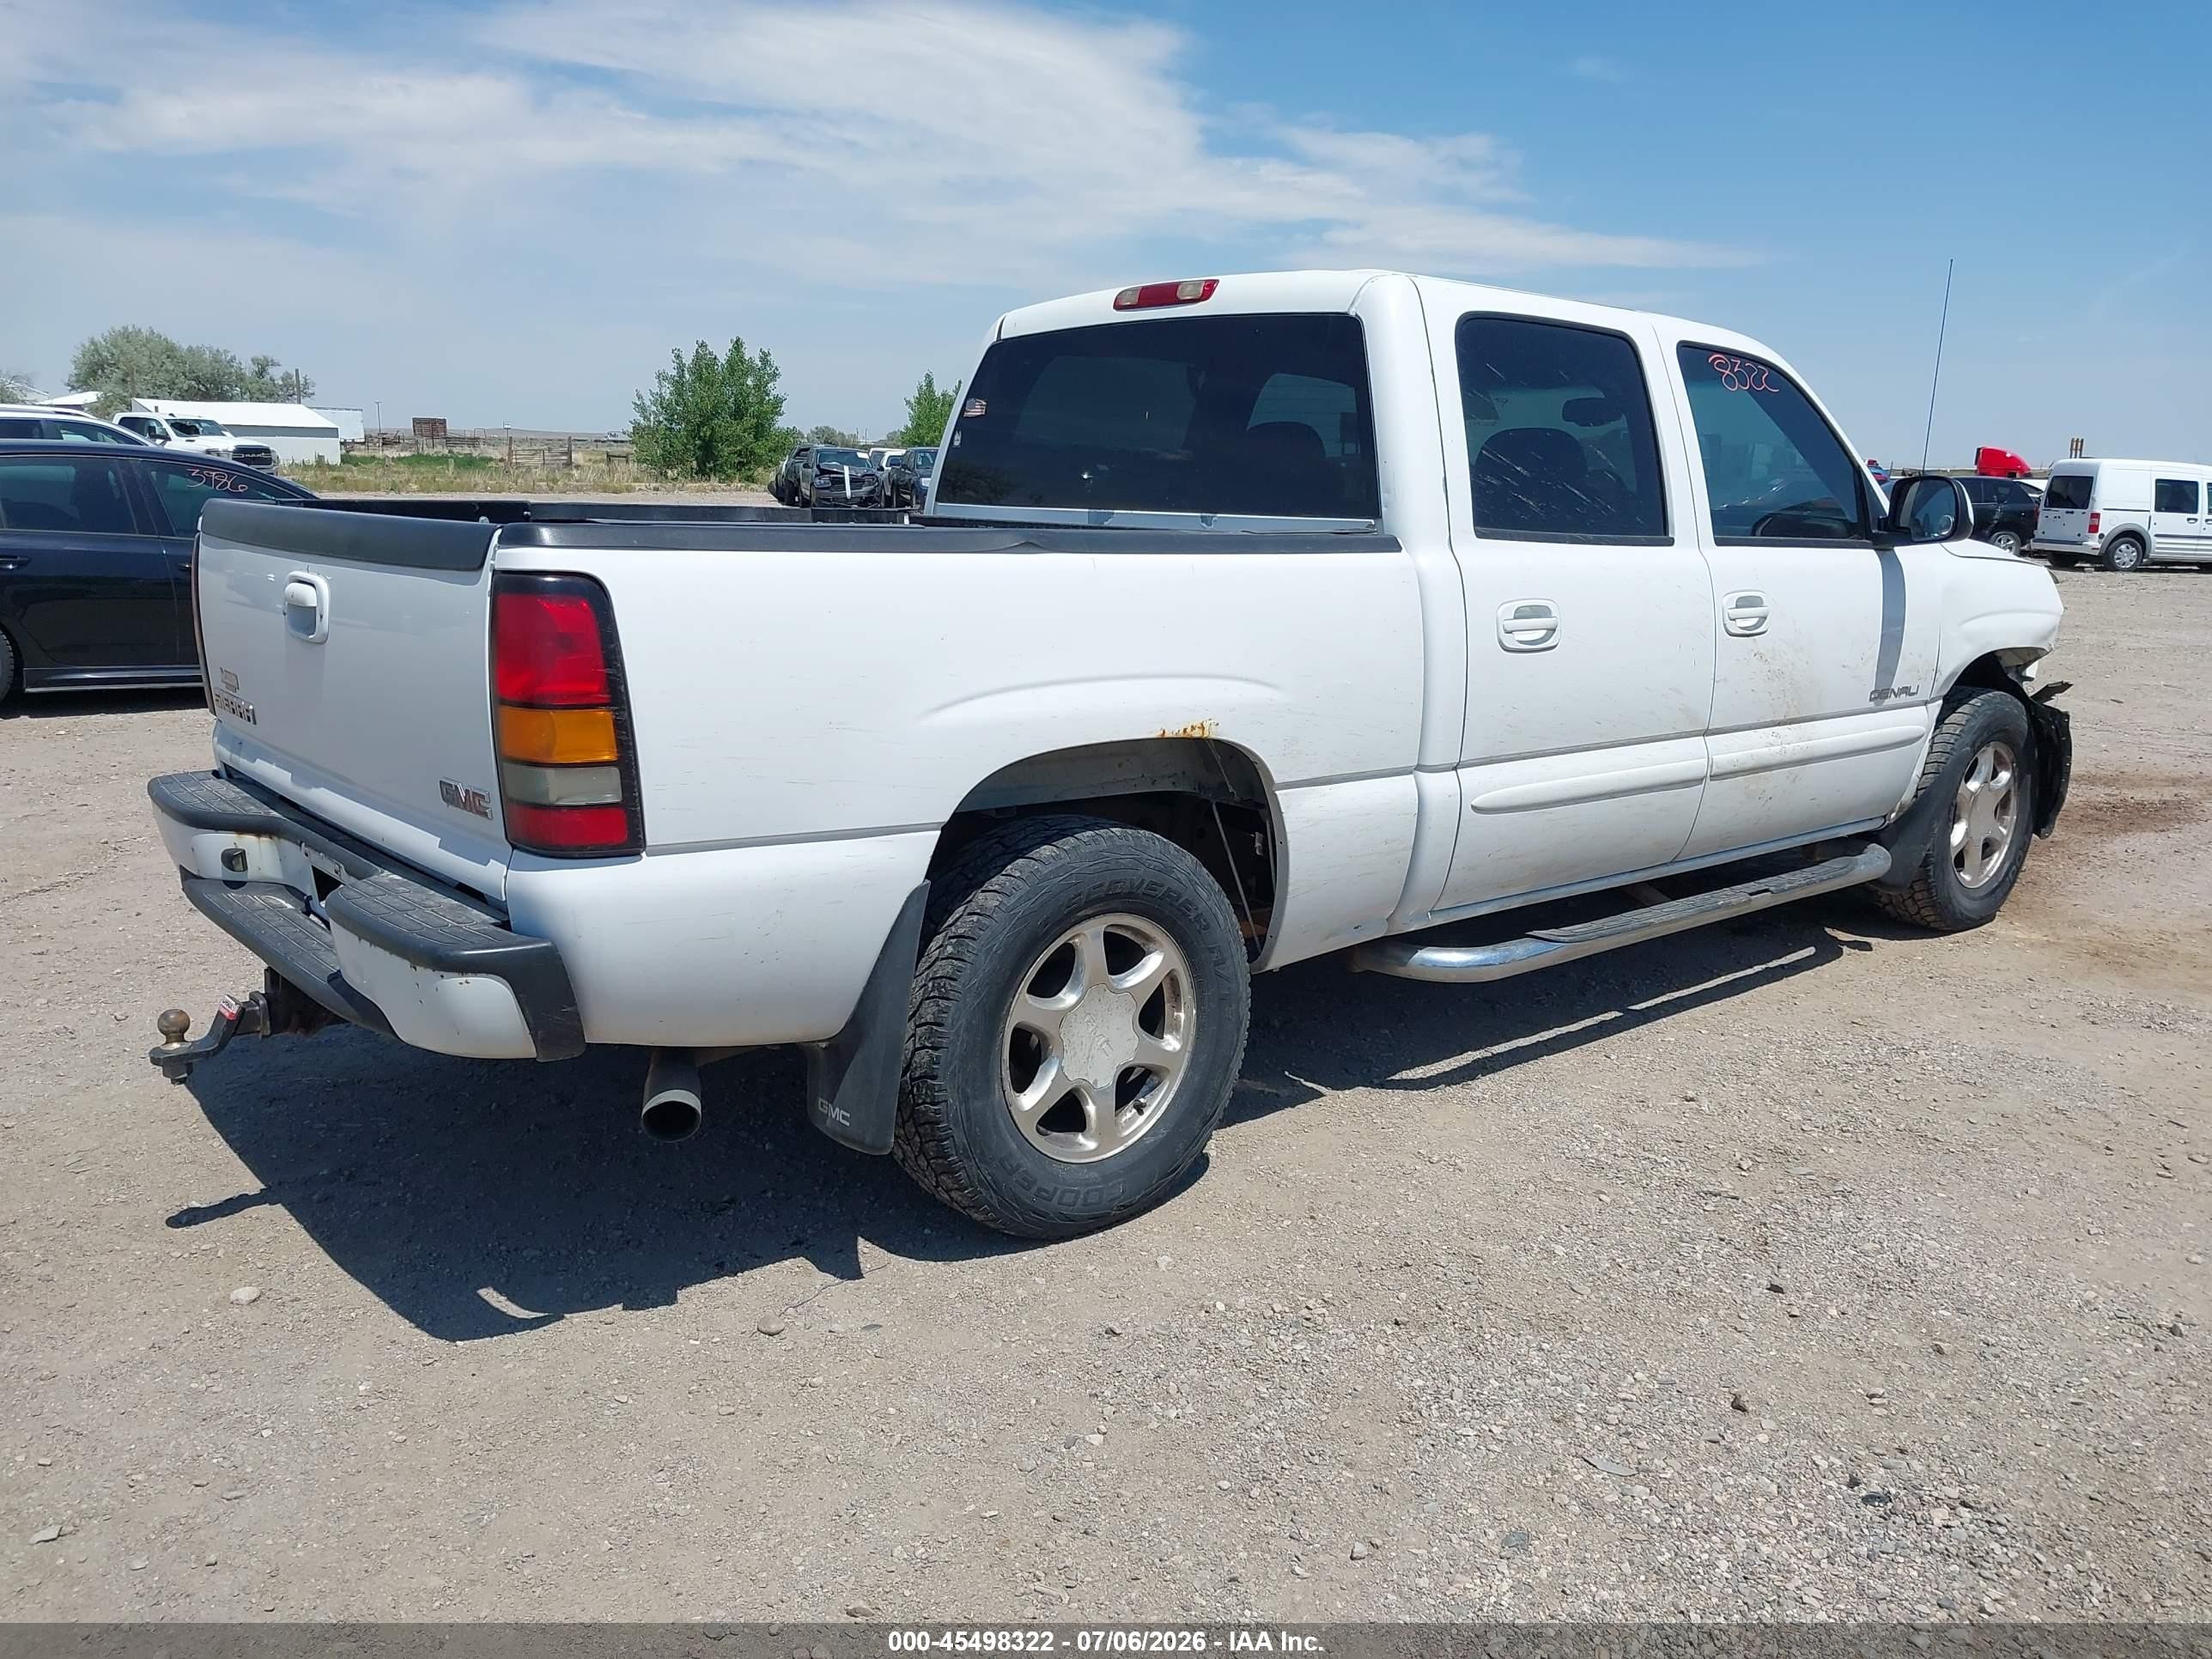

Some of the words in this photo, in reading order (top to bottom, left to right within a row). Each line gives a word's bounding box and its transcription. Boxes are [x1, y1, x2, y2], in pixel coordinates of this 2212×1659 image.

[1708, 354, 1780, 392] 8322
[185, 468, 249, 493] 3986
[212, 689, 258, 726] SIERRA
[1869, 684, 1920, 702] DENALI
[439, 777, 494, 821] GMC
[818, 1097, 850, 1127] GMC
